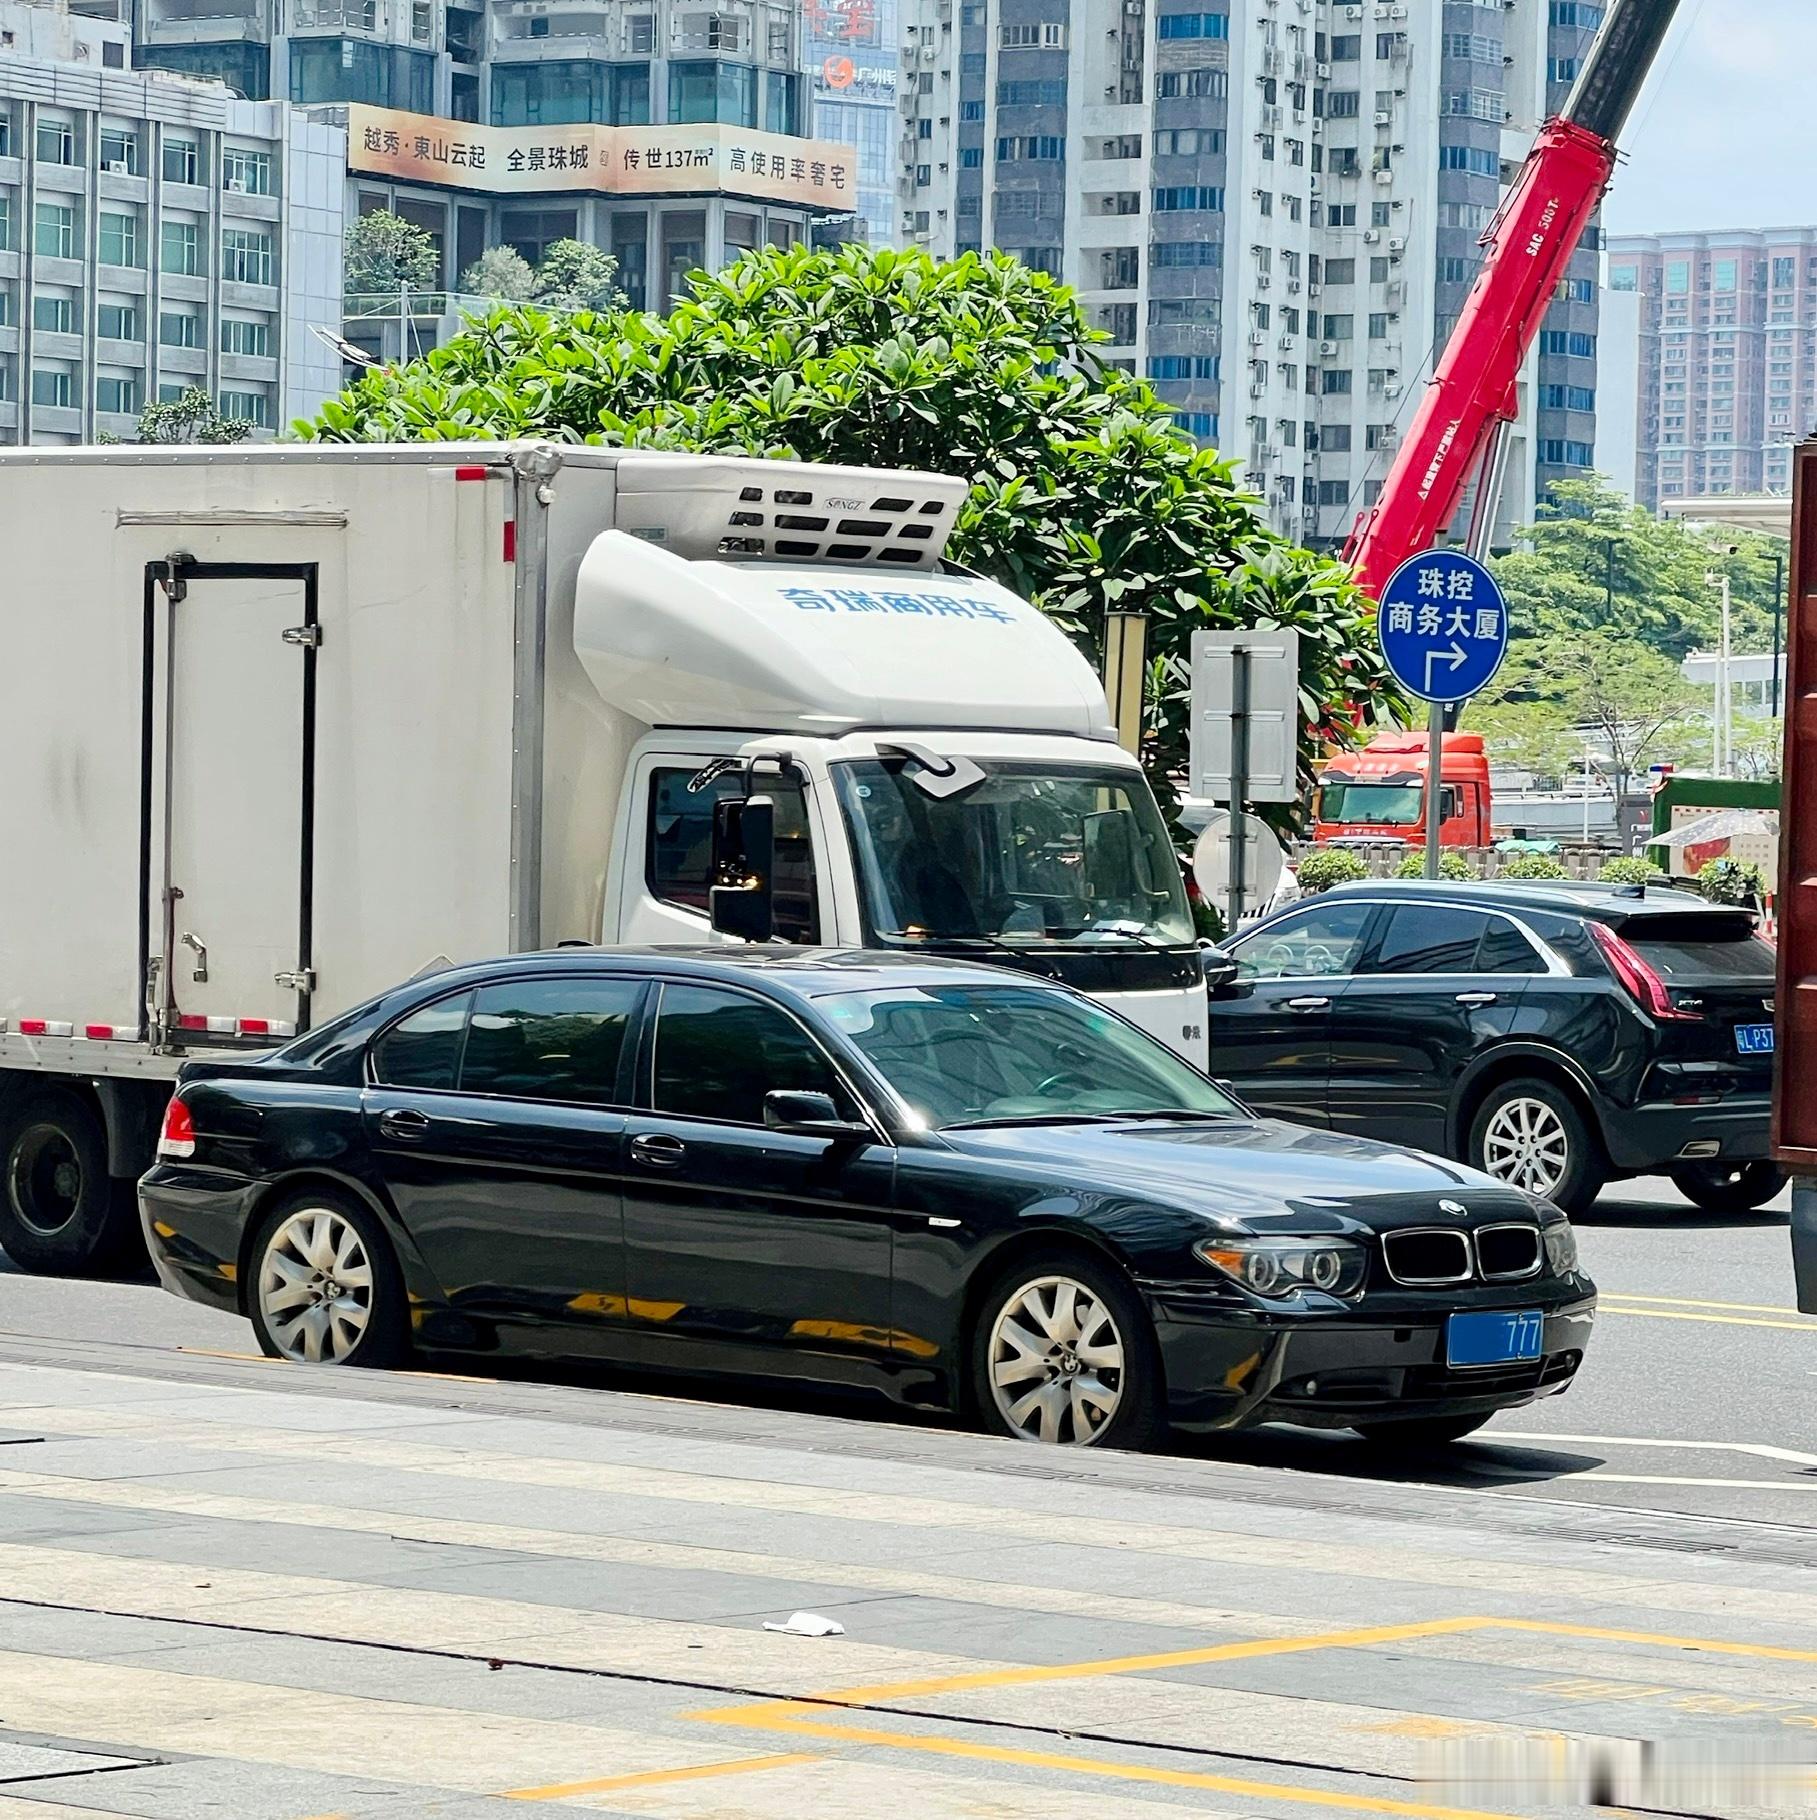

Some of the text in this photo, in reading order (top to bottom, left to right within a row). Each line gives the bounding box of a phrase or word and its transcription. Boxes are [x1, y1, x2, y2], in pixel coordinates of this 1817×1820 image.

[507, 144, 589, 172] 全景珠城
[730, 147, 846, 190] 高使用率奢宅
[1525, 233, 1545, 257] SAC
[1418, 568, 1474, 601] 珠控
[776, 587, 1017, 624] 奇瑞商用车
[1387, 601, 1500, 641] 商务大厦
[1507, 1318, 1541, 1353] 777
